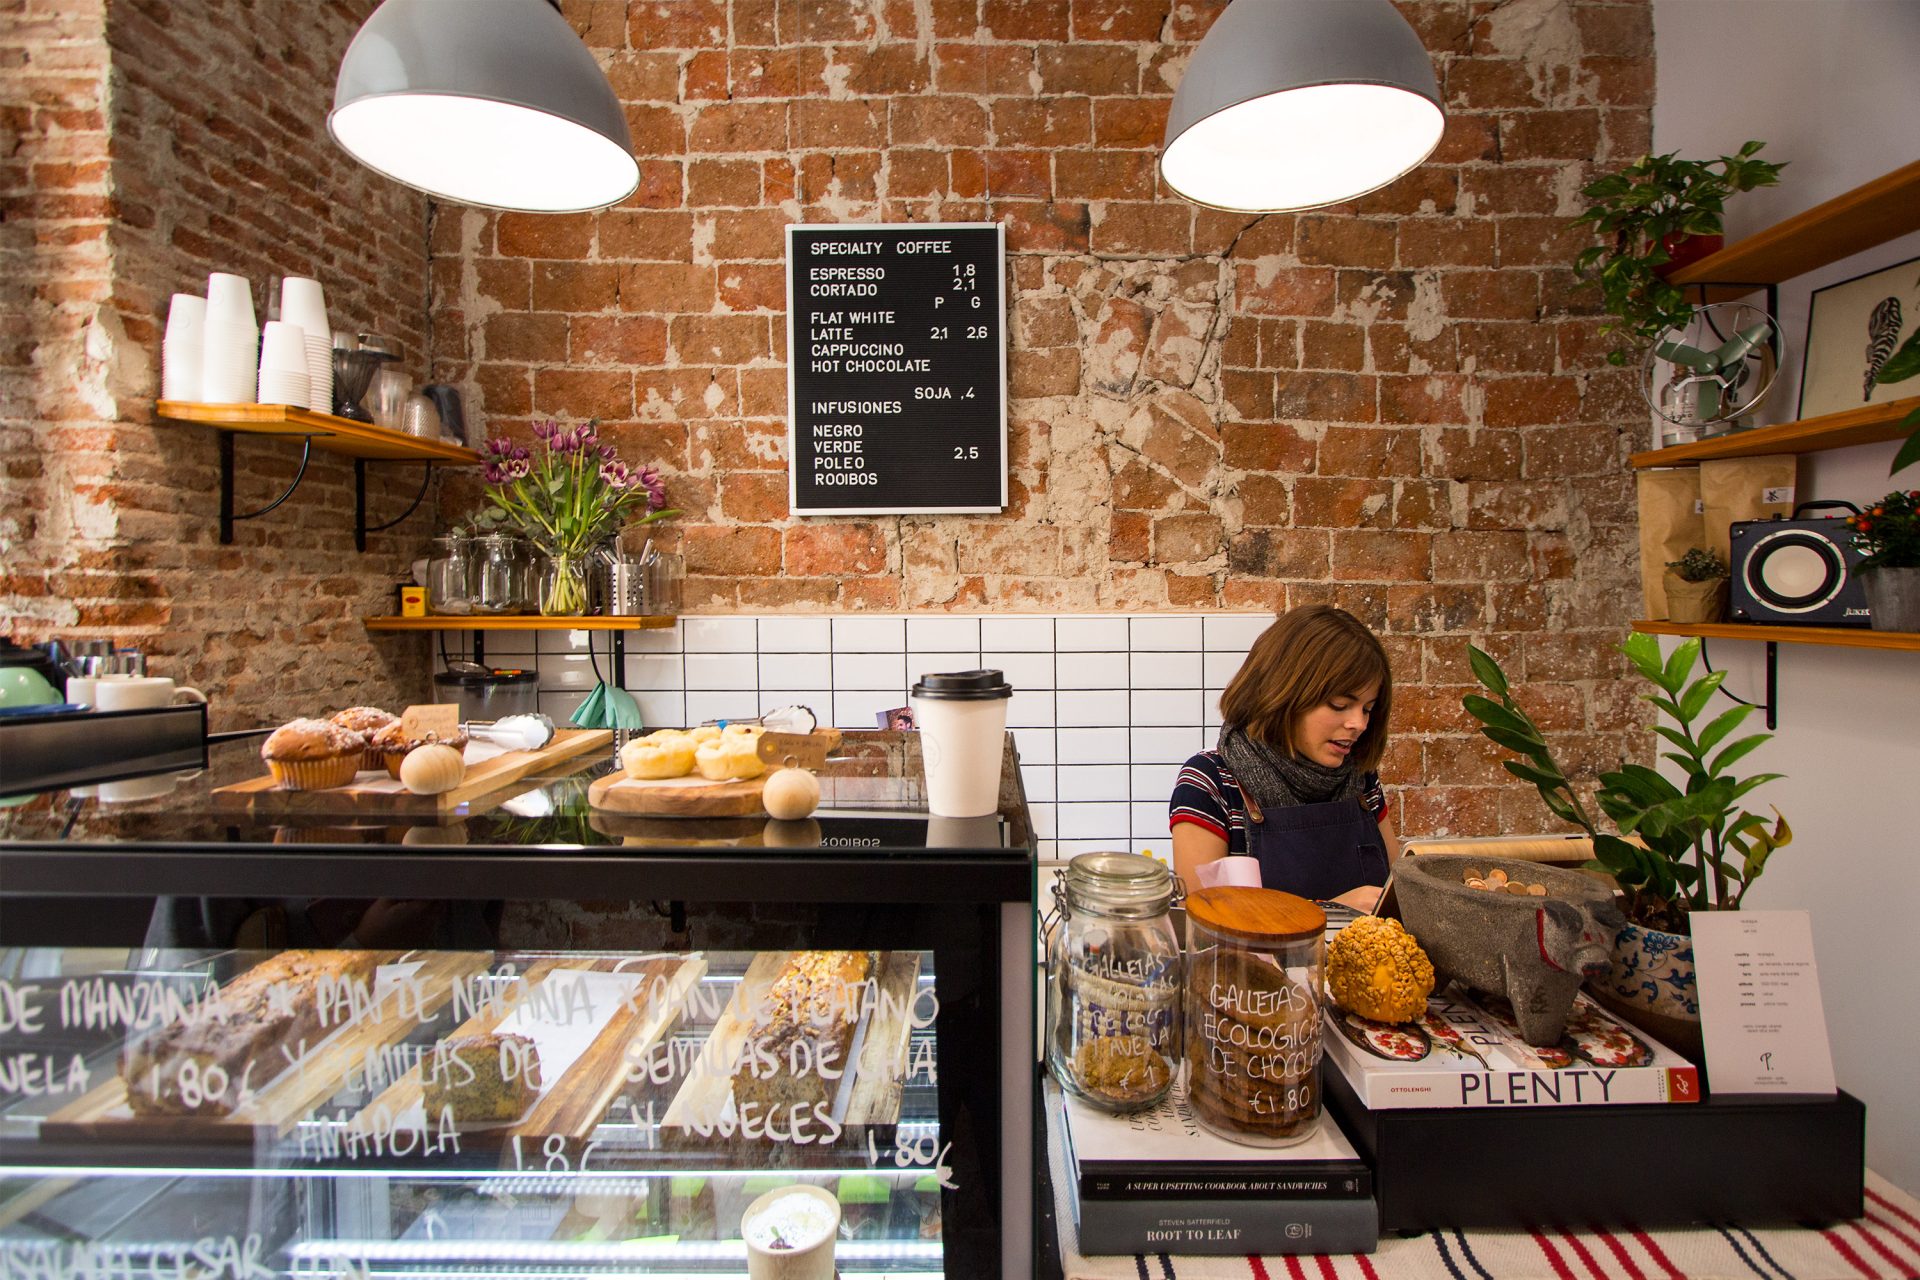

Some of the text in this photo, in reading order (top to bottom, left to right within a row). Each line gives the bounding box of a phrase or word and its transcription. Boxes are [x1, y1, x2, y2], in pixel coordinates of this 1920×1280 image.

[810, 240, 952, 256] SPECIALTY COFFEE
[810, 267, 885, 281] ESPRESSO
[810, 283, 878, 297] CORTADO
[934, 296, 981, 309] P G
[810, 311, 896, 325] FLAT WHITE
[811, 327, 854, 341] LATTE
[811, 343, 904, 357] CAPPUCCINO
[811, 359, 931, 373] HOT CHOCOLATE
[914, 386, 952, 400] SOJA
[812, 400, 902, 415] INFUSIONES
[813, 424, 863, 438] NEGRO
[813, 440, 863, 454] VERDE
[814, 456, 865, 470] POLEO
[815, 472, 878, 486] ROOIBOS
[1082, 952, 1166, 979] GALLETAS
[316, 965, 598, 1028] PAN DE NARANJA
[648, 974, 940, 1029] PAN DE PLATANO
[1210, 983, 1308, 1017] GALLETAS
[0, 977, 231, 1034] DE MANZANA
[335, 1039, 476, 1094] EMILLAS
[499, 1040, 543, 1090] DE
[621, 1039, 938, 1087] SEMILLAS DE CHIA
[1209, 1045, 1237, 1078] DE
[1390, 1070, 1617, 1106] OTTOLENGHI PLENTY
[680, 1100, 842, 1146] NUECES
[299, 1101, 461, 1162] AMAPOLA
[1125, 1182, 1328, 1191] A SUPER UPSETTING COOKBOOK ABOUT SANDWICHES
[1159, 1219, 1185, 1227] STEVEN
[1147, 1229, 1242, 1242] ROOT TO LEAF
